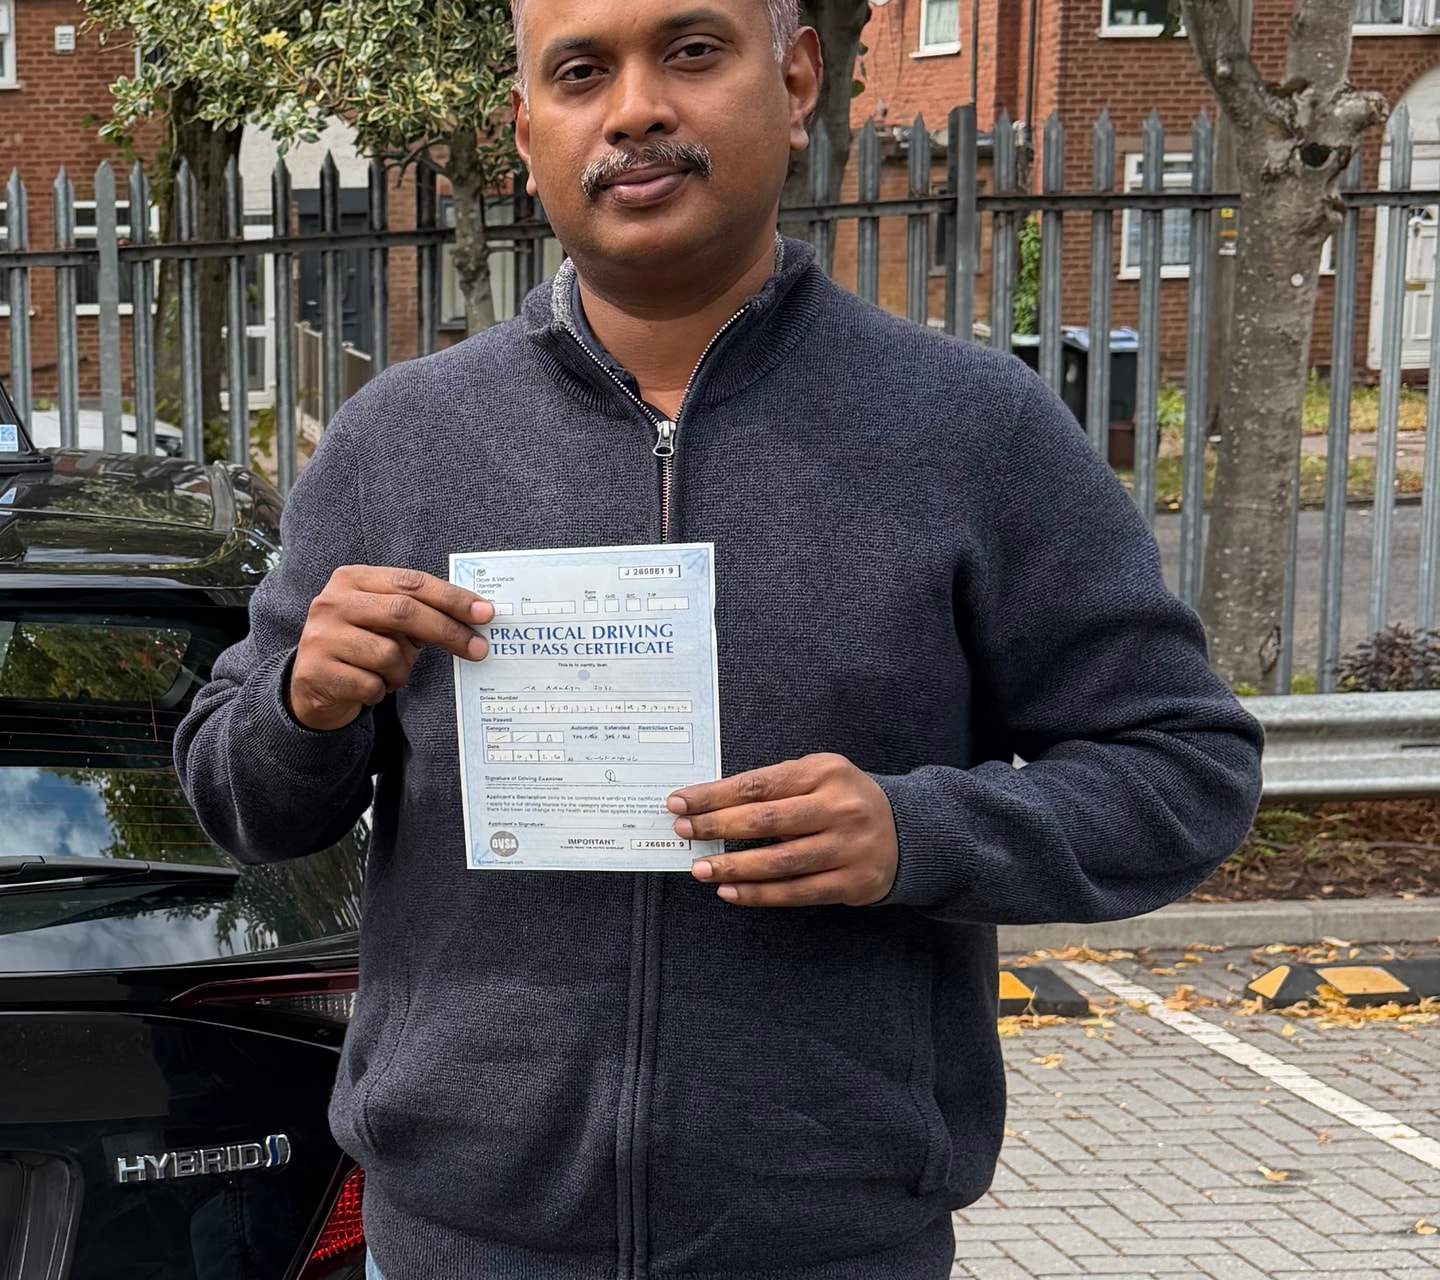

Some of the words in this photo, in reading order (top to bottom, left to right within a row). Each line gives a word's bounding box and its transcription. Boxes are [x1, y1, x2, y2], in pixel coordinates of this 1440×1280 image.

[490, 626, 586, 641] PRACTICAL
[592, 624, 673, 639] DRIVING
[491, 643, 526, 655] TEST
[531, 643, 569, 655] PASS
[573, 641, 674, 655] CERTIFICATE
[492, 838, 517, 849] DVSA
[117, 1142, 264, 1183] HYBRID
